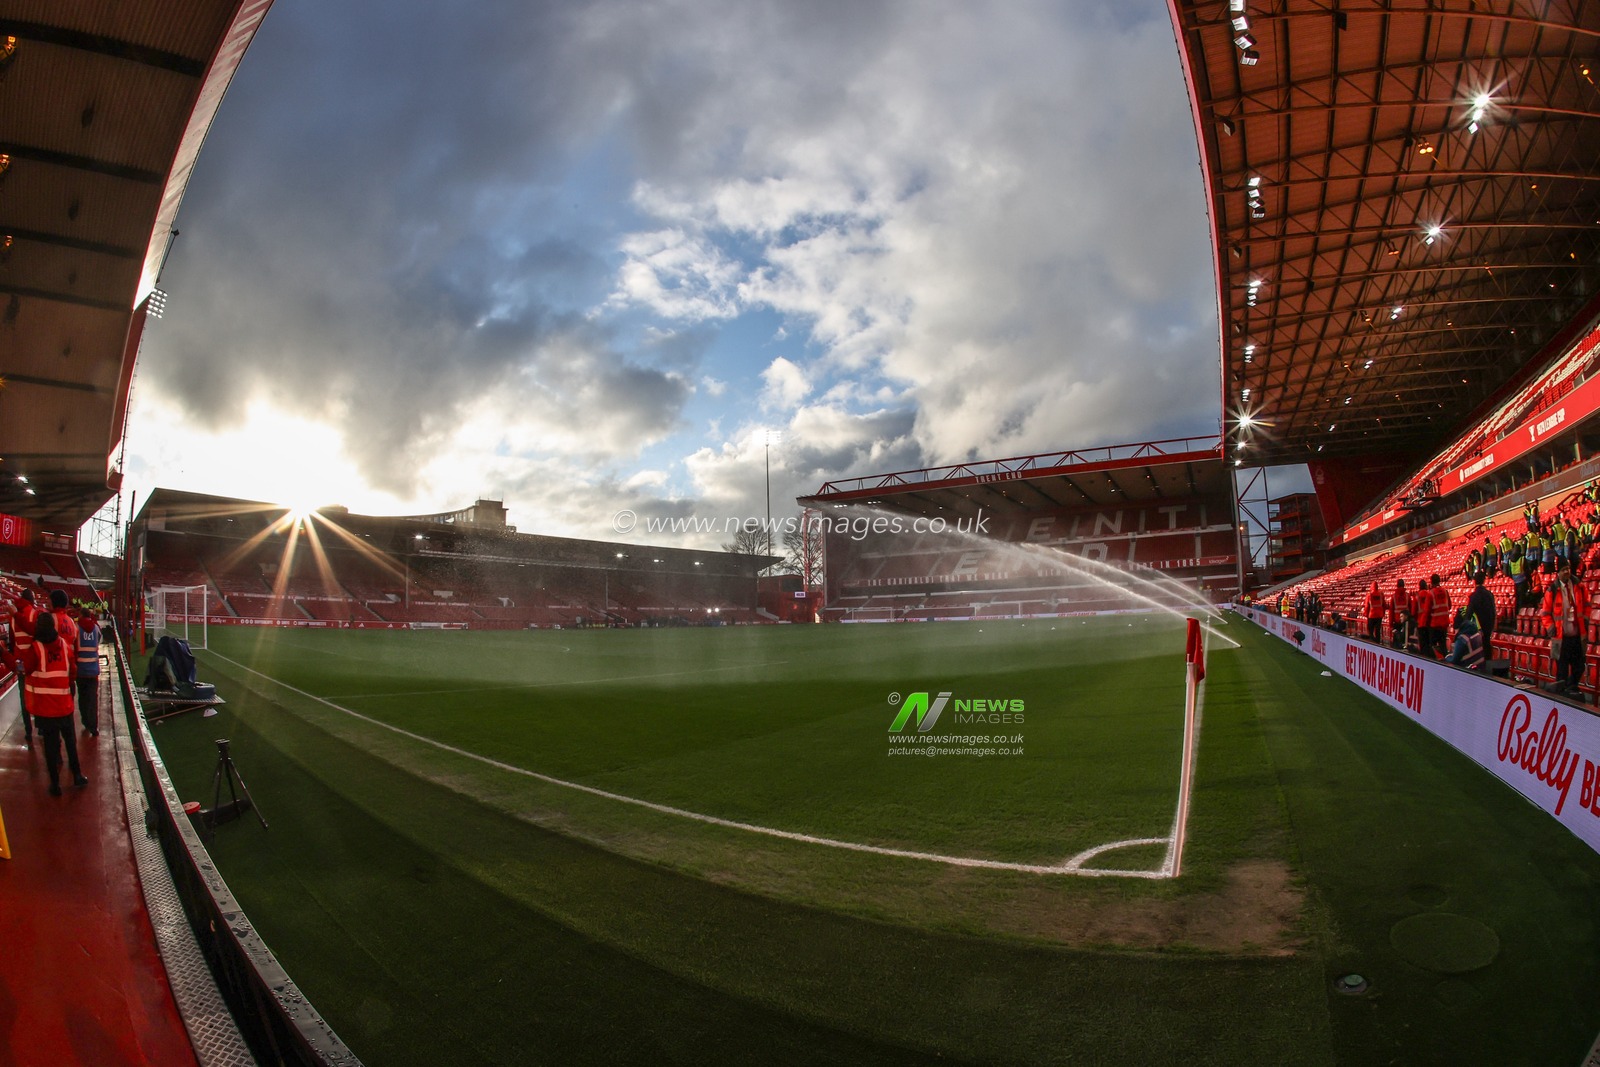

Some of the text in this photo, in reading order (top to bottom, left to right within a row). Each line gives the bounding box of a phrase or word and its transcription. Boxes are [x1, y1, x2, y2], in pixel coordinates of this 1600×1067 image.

[975, 472, 1022, 483] TRENT END
[1177, 559, 1200, 567] 1865
[1346, 643, 1424, 714] GET YOUR GAME ON
[1498, 694, 1600, 818] Bally BE
